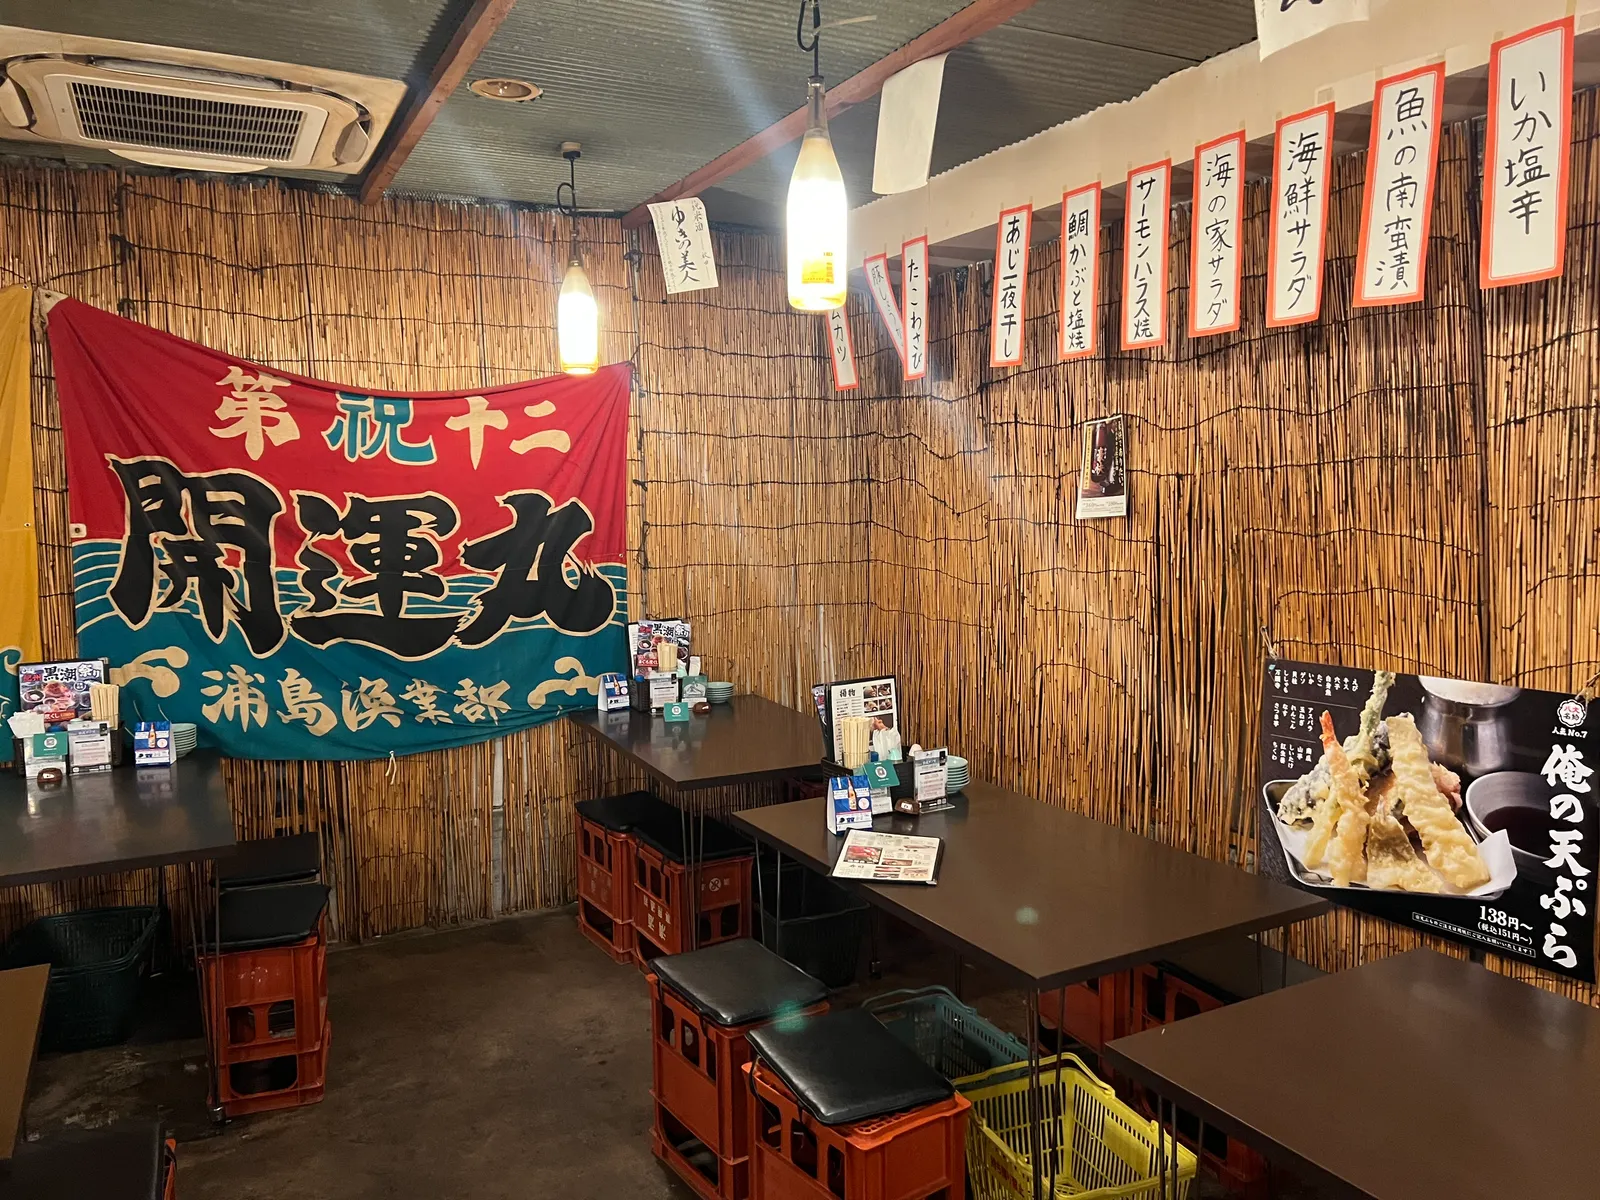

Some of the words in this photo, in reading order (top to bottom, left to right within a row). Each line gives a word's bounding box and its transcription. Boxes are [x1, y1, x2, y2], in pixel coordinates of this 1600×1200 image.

[1283, 132, 1323, 311] 海鮮サラダ
[1374, 87, 1428, 291] 魚の南蛮漬
[1505, 71, 1552, 235] いか塩辛
[671, 205, 700, 285] ゆきの美人
[1000, 216, 1021, 358] あじ一夜干し
[1067, 208, 1089, 350] 鯛かぶと塩焼
[1133, 176, 1156, 340] サーモンハラス焼
[1205, 153, 1235, 326] 海の家サラダ
[105, 453, 618, 662] 開運丸
[1540, 743, 1595, 969] 俺の天ぷら
